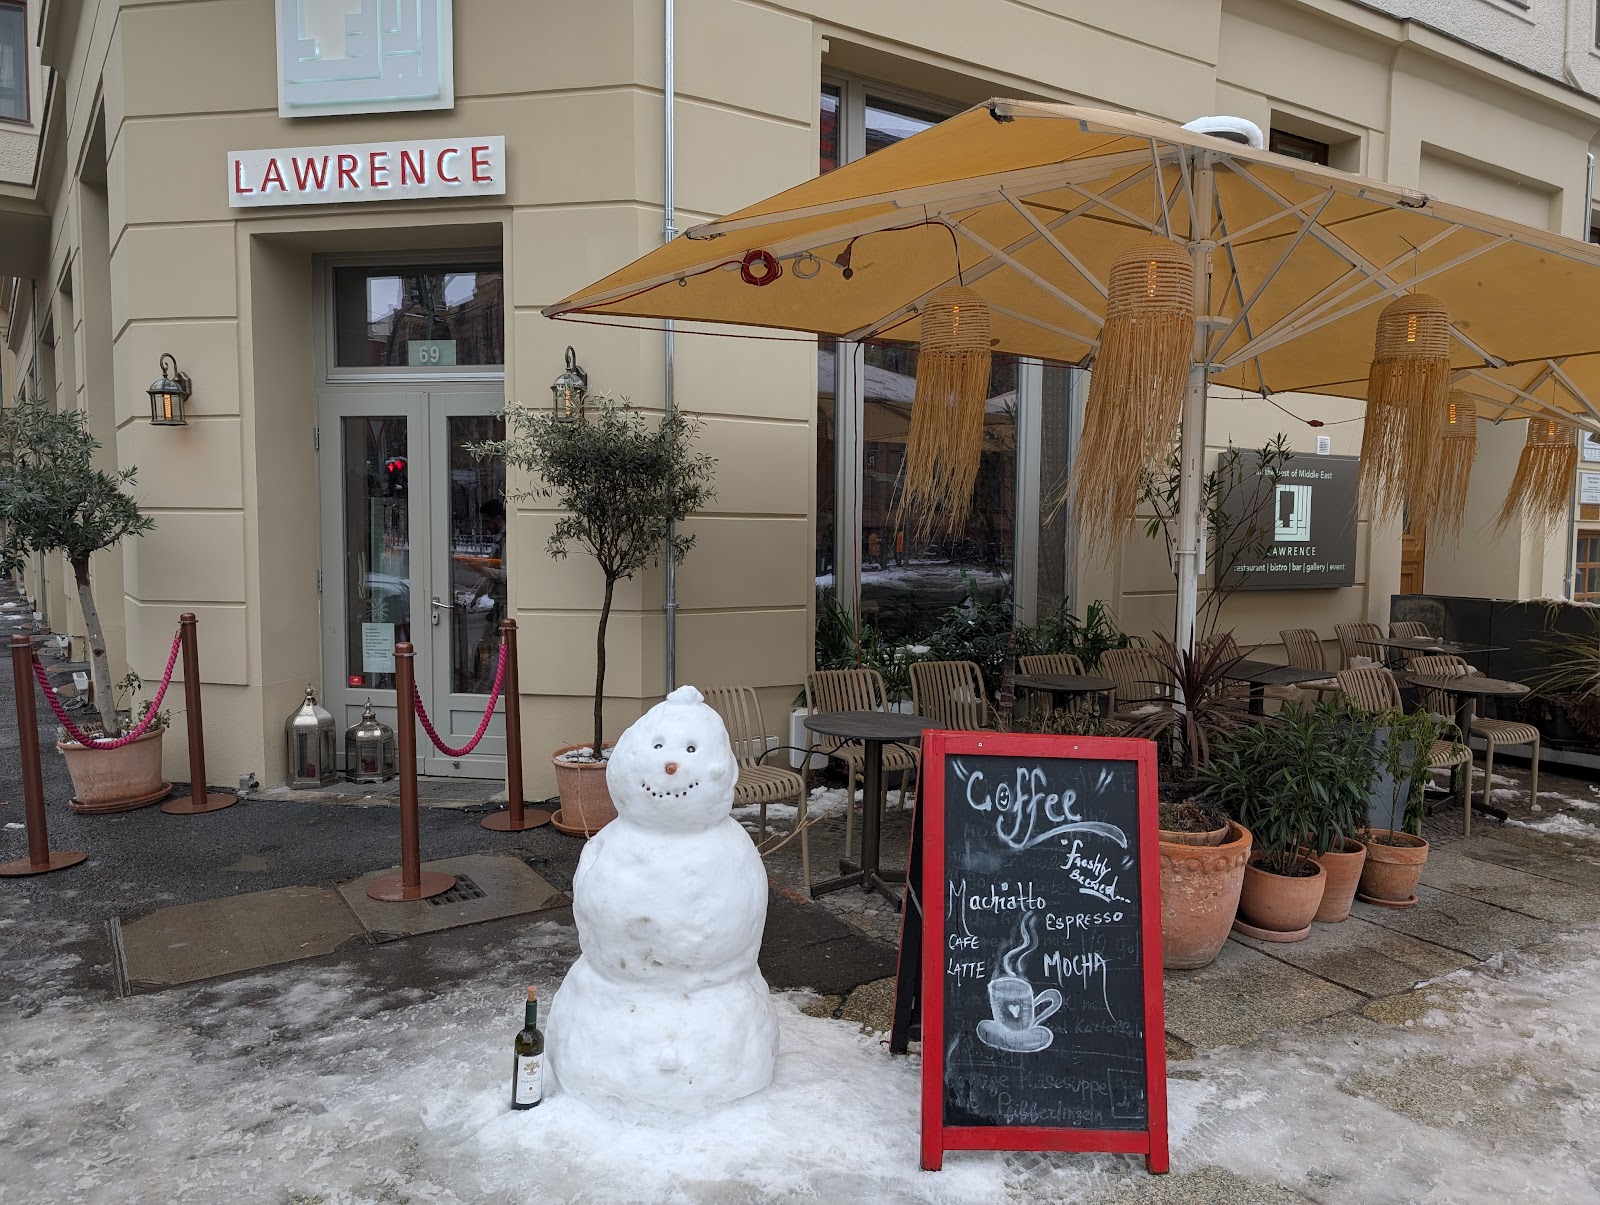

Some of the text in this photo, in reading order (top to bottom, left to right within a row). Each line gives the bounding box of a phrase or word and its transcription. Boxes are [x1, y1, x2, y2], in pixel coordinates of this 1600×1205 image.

[234, 146, 494, 194] LAWRENCE
[419, 346, 440, 363] 69
[1291, 469, 1298, 478] of
[1299, 469, 1319, 479] Middle
[1320, 470, 1333, 480] East
[1267, 546, 1316, 556] AWRENCE
[1270, 562, 1288, 572] bistro
[1292, 562, 1302, 572] bar
[1306, 562, 1325, 573] gallery
[1329, 562, 1346, 571] event
[946, 878, 1046, 934] Machiatto
[948, 933, 980, 950] CAFE
[946, 958, 985, 987] LATTE
[1043, 950, 1114, 1007] MOCHA
